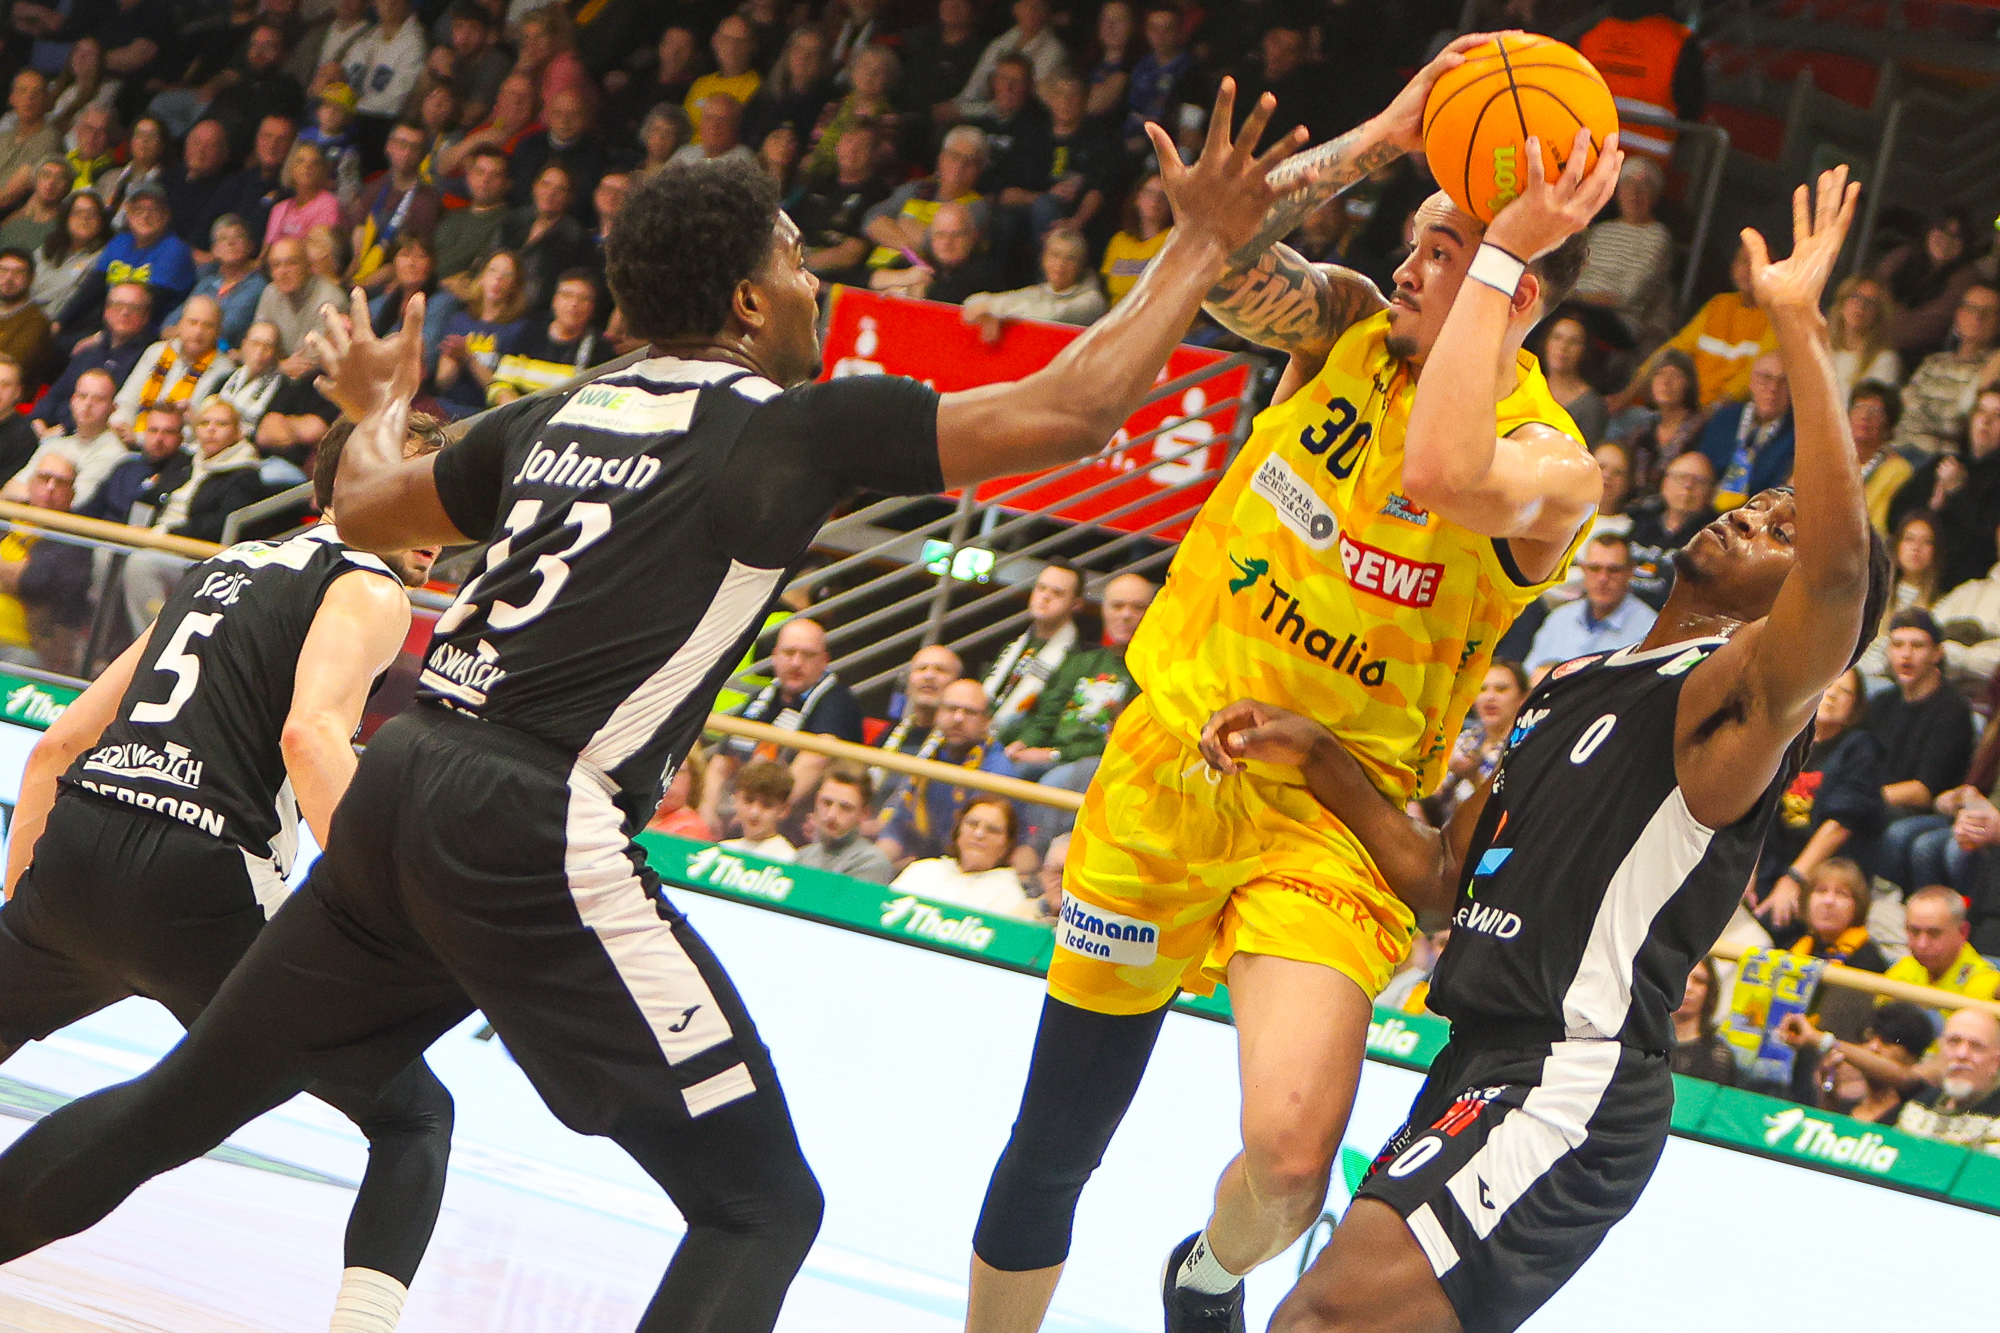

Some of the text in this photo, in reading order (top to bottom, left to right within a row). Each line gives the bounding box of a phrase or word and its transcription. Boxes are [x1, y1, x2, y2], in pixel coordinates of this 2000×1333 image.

[576, 389, 633, 410] WNE
[1299, 397, 1373, 480] 30
[433, 499, 613, 634] 13
[1340, 537, 1437, 603] REWE
[1260, 579, 1387, 687] Thalia
[129, 611, 225, 723] 5
[1569, 713, 1618, 765] 0
[708, 854, 795, 901] Thalia
[905, 902, 995, 951] Thalia
[1793, 1116, 1899, 1173] Thalia
